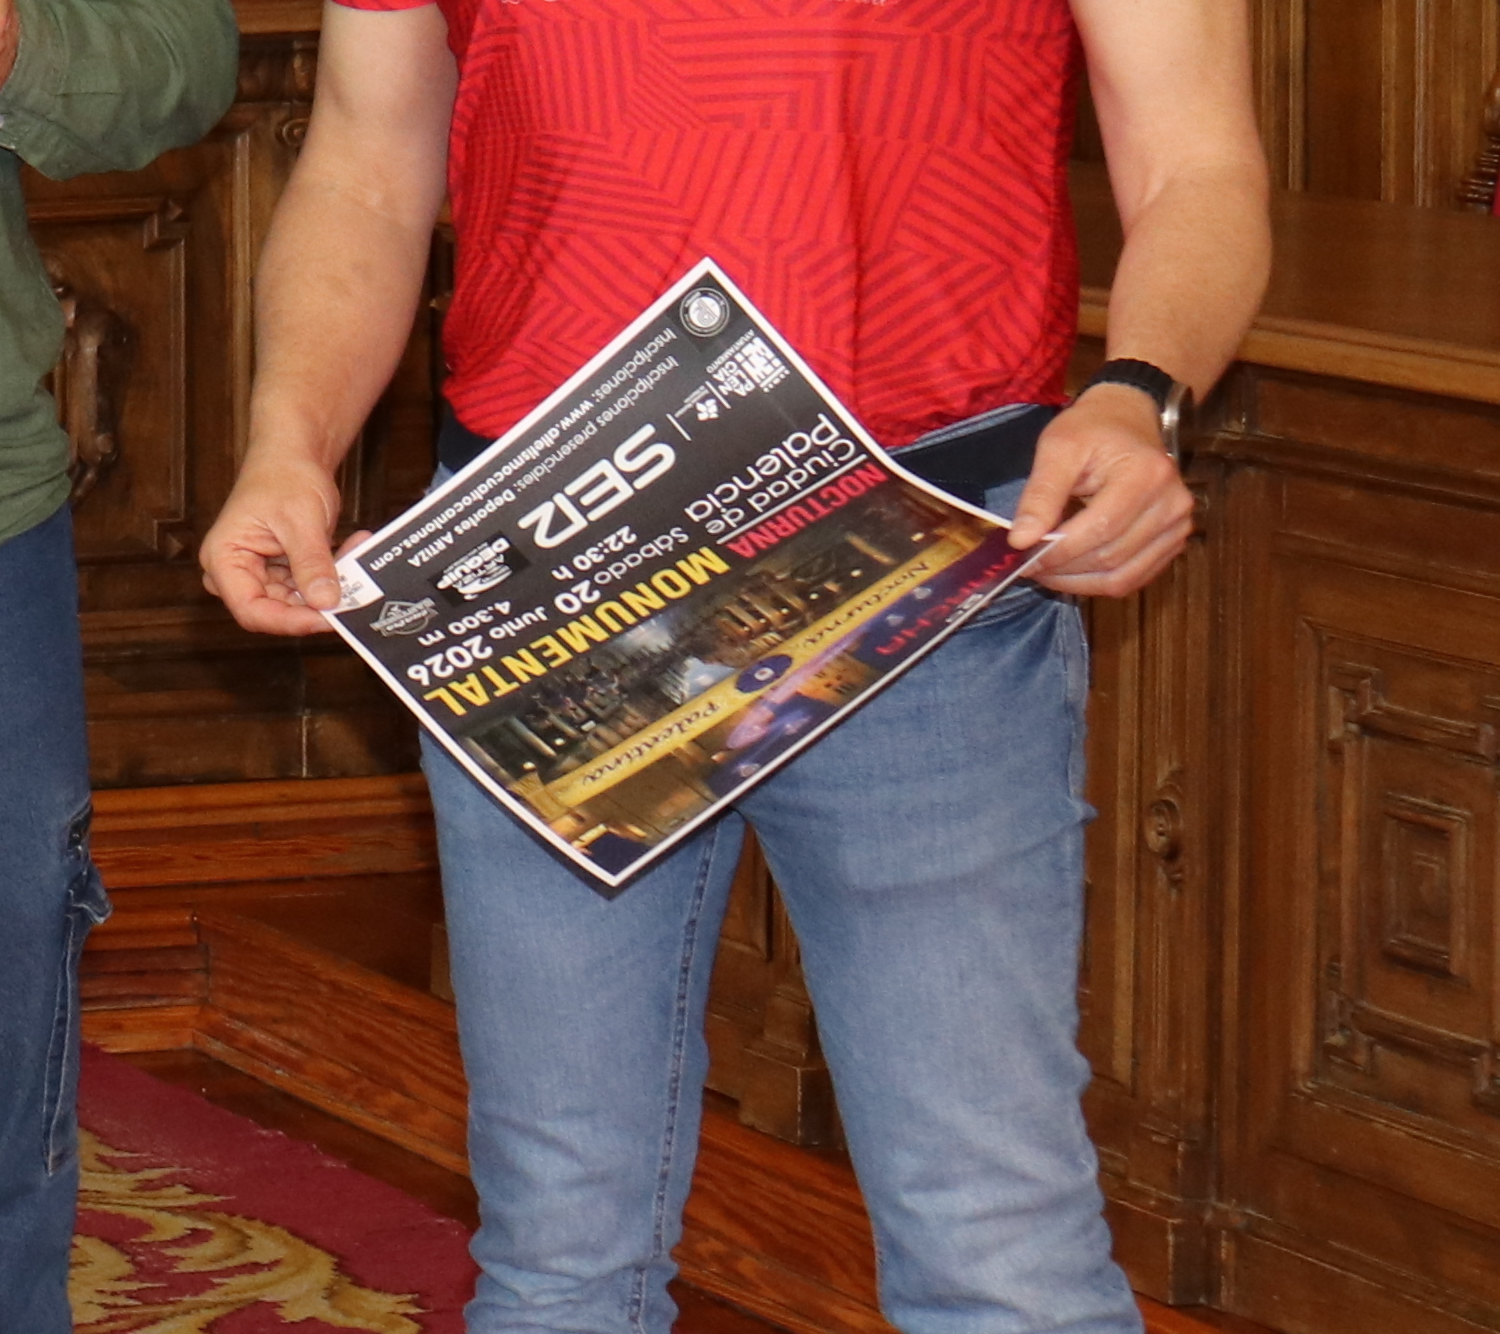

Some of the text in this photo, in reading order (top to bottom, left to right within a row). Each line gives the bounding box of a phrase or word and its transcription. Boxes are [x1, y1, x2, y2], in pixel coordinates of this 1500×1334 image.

[369, 399, 594, 572] www.atletismocuatrocantones.com
[519, 425, 674, 547] SER
[684, 415, 838, 522] Palencia
[705, 438, 854, 534] Ciudad de
[423, 462, 884, 716] NOCTURNA MONUMENTAL
[571, 525, 636, 570] 22:30
[407, 526, 688, 686] Sábado 20 Junio 2026
[447, 599, 513, 635] 4.300
